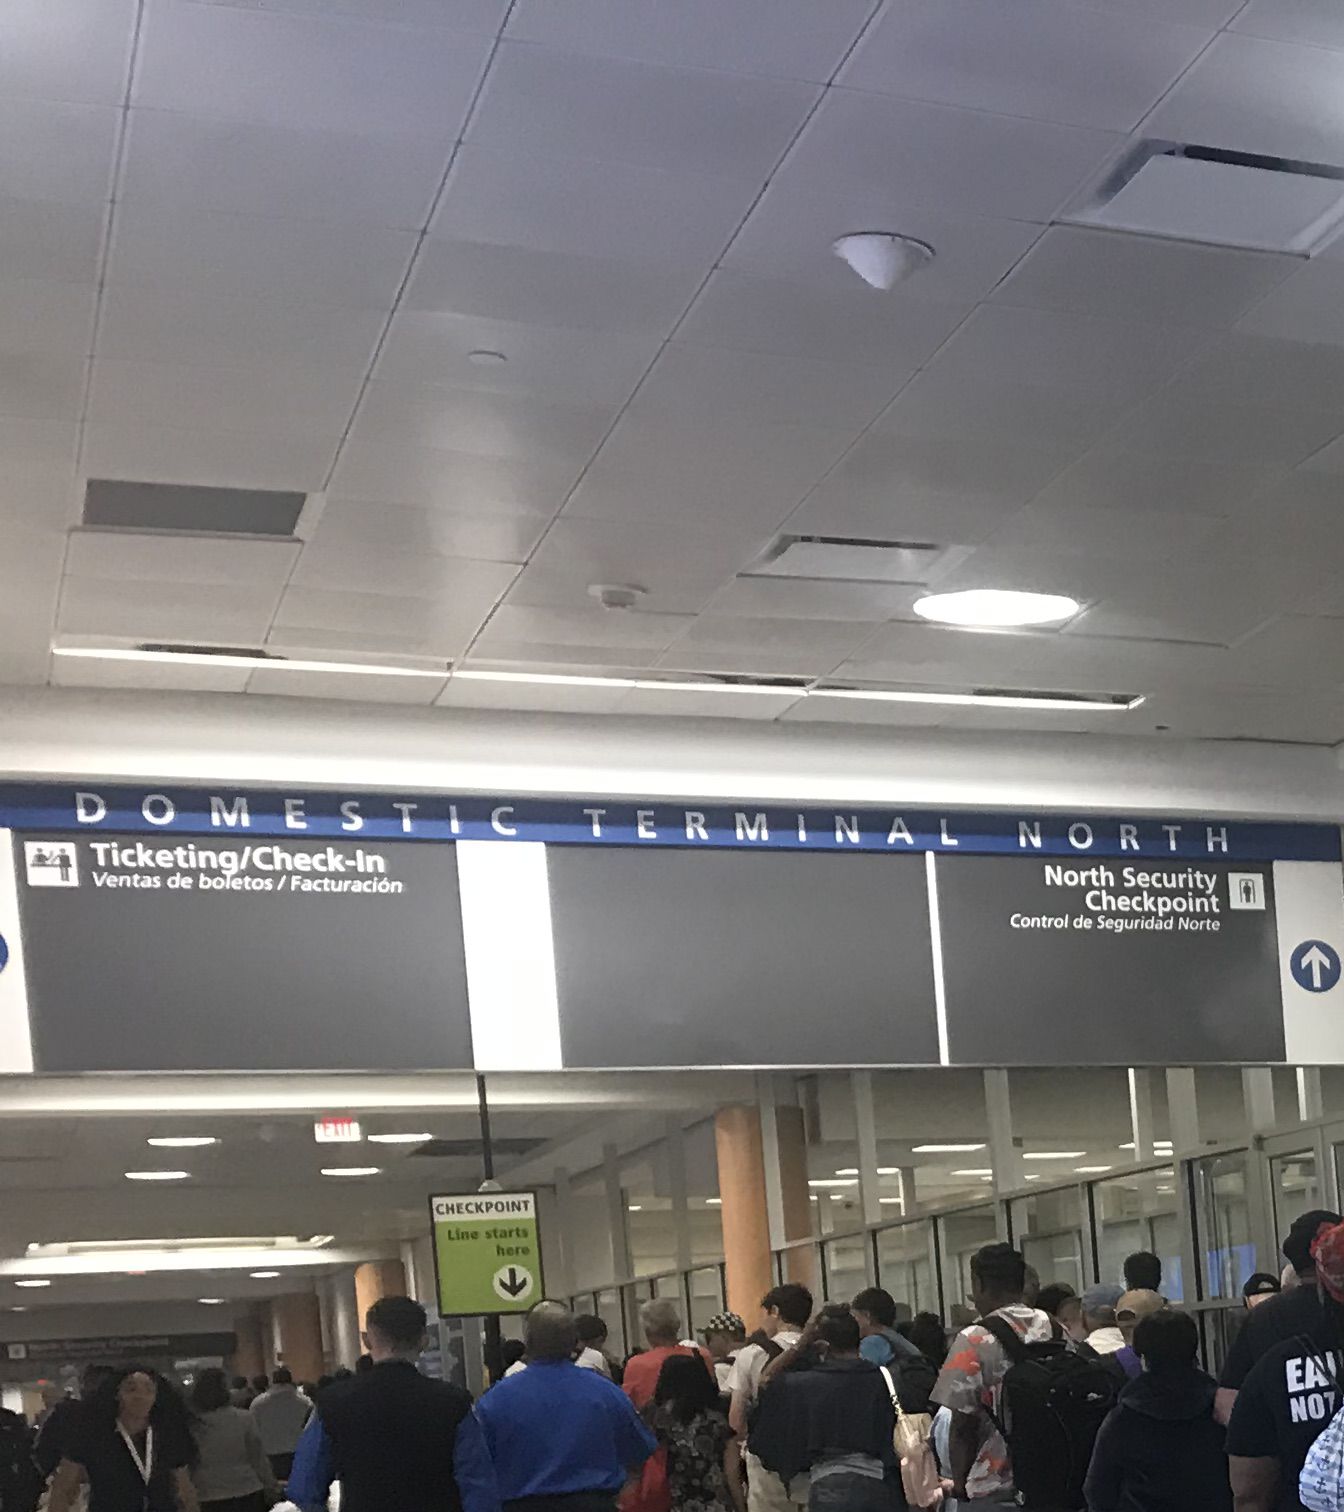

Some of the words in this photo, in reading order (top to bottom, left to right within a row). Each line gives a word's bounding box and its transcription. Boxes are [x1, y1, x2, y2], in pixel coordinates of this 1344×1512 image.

[75, 791, 518, 836] DOMESTIC
[583, 808, 958, 846] TERMINAL
[1018, 820, 1229, 853] NORTH
[90, 842, 385, 875] Ticketing/Check-In
[92, 871, 161, 889] Ventas
[167, 872, 193, 890] de
[199, 873, 272, 891] boletos
[276, 875, 287, 891] /
[290, 875, 403, 893] Facturación
[1044, 865, 1115, 887] North
[1122, 867, 1217, 894] Security
[1085, 890, 1220, 916] Checkpoint
[1010, 913, 1069, 929] Control
[1073, 914, 1093, 930] de
[1096, 915, 1174, 933] Seguridad
[1178, 916, 1221, 931] Norte
[435, 1200, 530, 1216] CHECKPOINT
[447, 1227, 479, 1241] Line
[485, 1226, 529, 1240] starts
[496, 1244, 530, 1257] here
